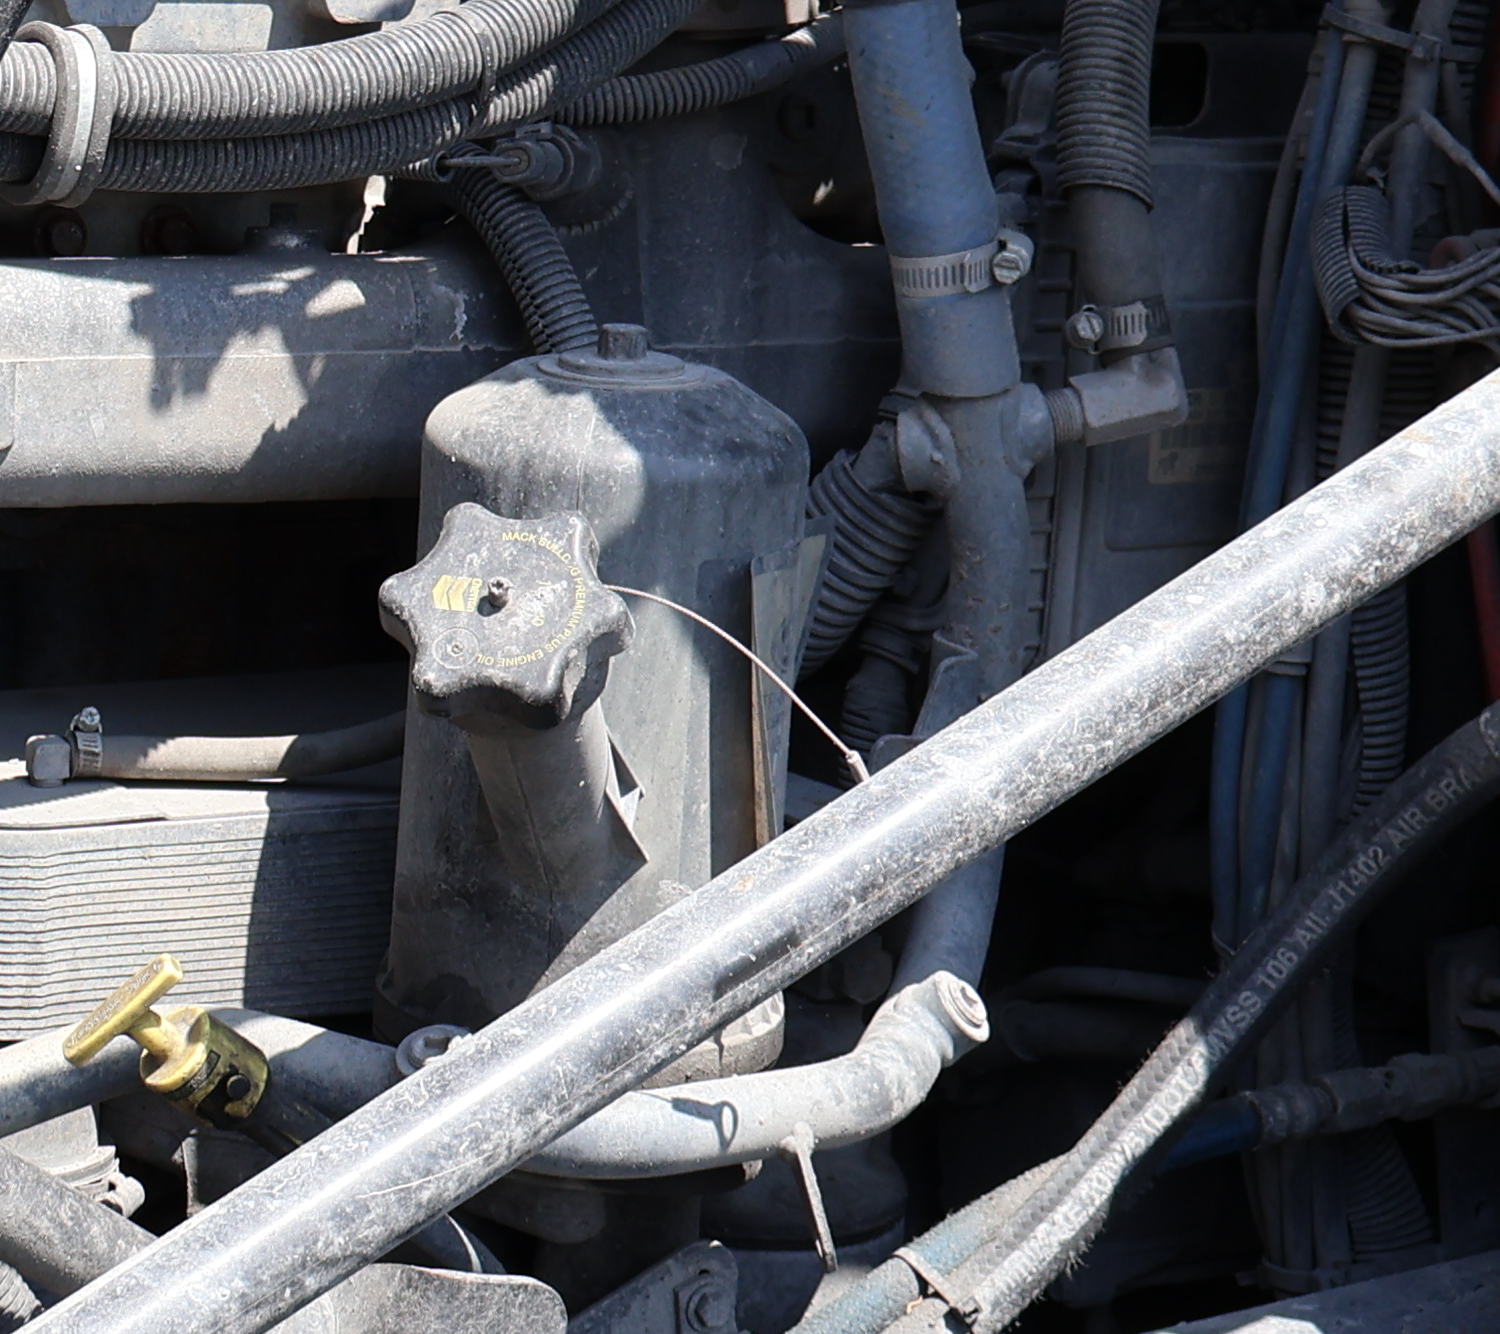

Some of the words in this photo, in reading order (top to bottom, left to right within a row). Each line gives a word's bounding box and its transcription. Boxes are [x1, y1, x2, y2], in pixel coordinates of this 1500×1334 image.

[502, 531, 537, 543] MACK
[538, 536, 581, 576] BULLDG
[567, 576, 586, 628] PREMIUM
[545, 628, 573, 654] PLUS
[475, 652, 496, 667] OIL
[499, 648, 546, 667] ENGINE
[1393, 805, 1431, 850] AIR
